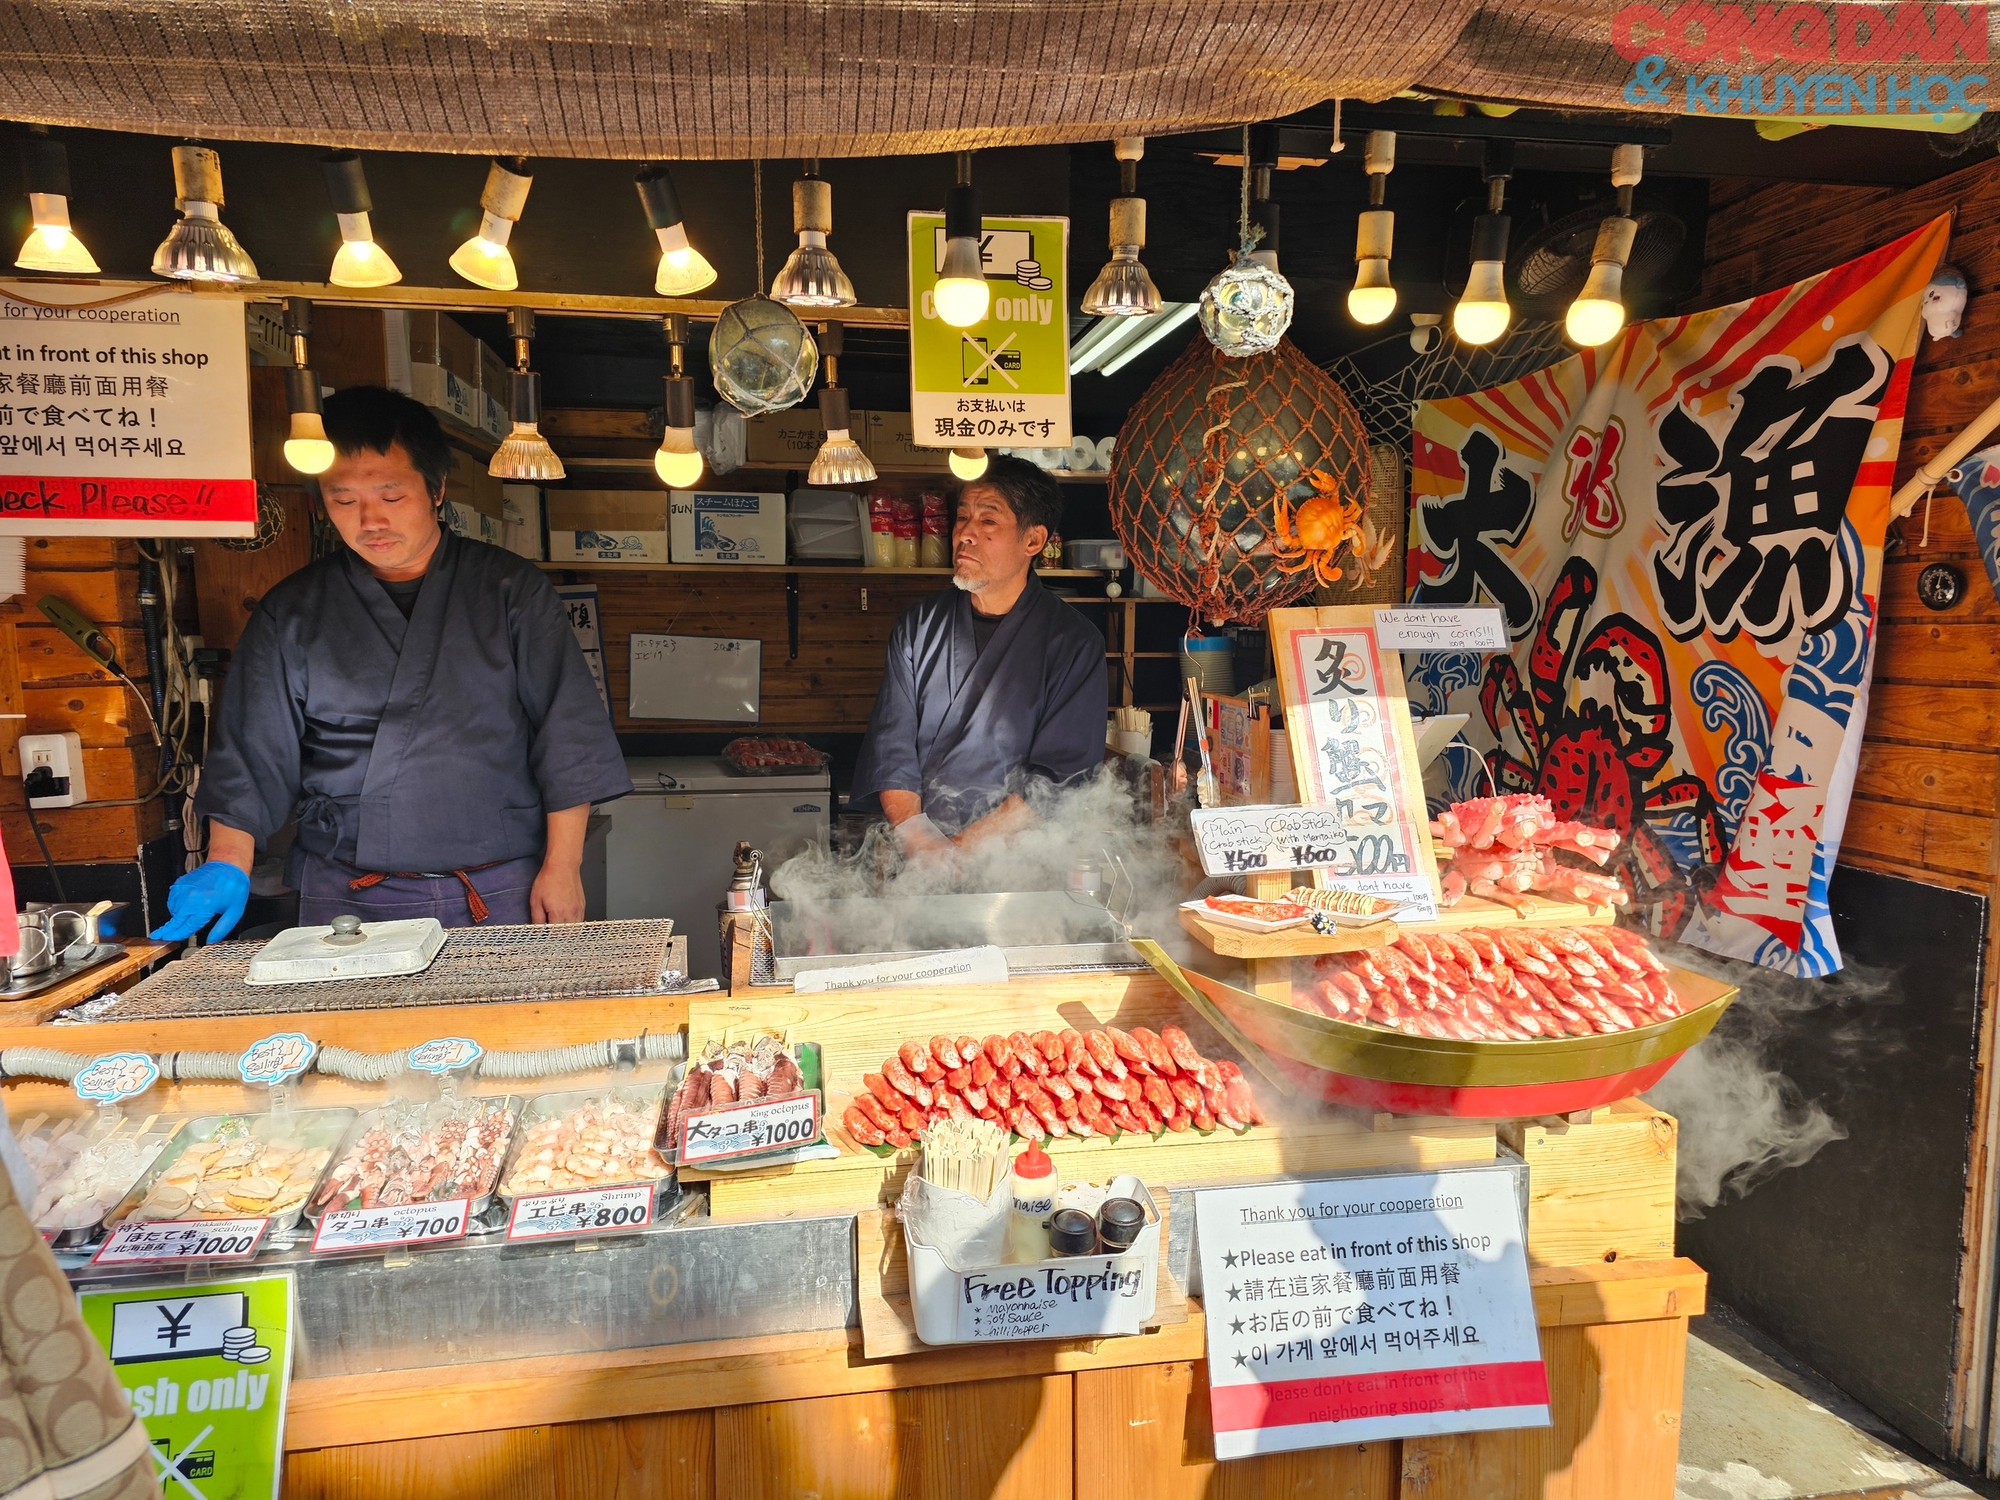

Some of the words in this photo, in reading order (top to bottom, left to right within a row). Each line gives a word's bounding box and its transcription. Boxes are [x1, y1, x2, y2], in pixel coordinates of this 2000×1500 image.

[4, 302, 28, 318] for
[33, 305, 71, 321] your
[78, 308, 181, 324] cooperation
[996, 294, 1053, 325] only
[16, 344, 35, 361] in
[40, 344, 90, 363] front
[95, 347, 117, 363] of
[121, 347, 157, 365] this
[162, 348, 209, 369] shop
[1003, 361, 1021, 369] CARD
[957, 398, 1026, 413] お支払いは
[935, 417, 1056, 438] 現金のみです
[0, 434, 67, 458] 앞에서
[75, 436, 187, 459] 먹어주세요
[0, 480, 65, 517] eck
[671, 503, 693, 515] JUN
[696, 496, 759, 509] スチームほたて
[1379, 612, 1400, 624] We
[1404, 612, 1427, 624] dont
[1430, 612, 1461, 624] have
[1398, 629, 1440, 643] enough
[1209, 823, 1242, 838] Plain
[1223, 850, 1268, 871] ¥500
[1290, 845, 1337, 866] ¥600
[1357, 880, 1379, 891] dont
[1383, 880, 1413, 890] have
[825, 979, 857, 990] Thank
[857, 977, 874, 987] you
[876, 974, 890, 984] for
[892, 971, 914, 982] your
[916, 962, 972, 978] cooperation
[251, 1043, 276, 1061] Best
[91, 1062, 119, 1076] Best
[750, 1110, 768, 1119] King
[771, 1102, 810, 1116] octopus
[687, 1119, 759, 1142] 大タコ串
[750, 1117, 814, 1147] ¥1000
[600, 1191, 641, 1202] Shrimp
[393, 1205, 437, 1216] octopus
[527, 1201, 586, 1220] エビ串
[576, 1205, 647, 1228] ¥800
[1240, 1206, 1286, 1223] Thank
[1288, 1206, 1316, 1222] you
[1319, 1202, 1340, 1217] for
[1343, 1201, 1376, 1218] your
[1379, 1194, 1463, 1214] cooperation
[117, 1223, 149, 1233] 特大
[212, 1224, 259, 1233] scallops
[330, 1216, 389, 1232] タコ串
[397, 1216, 460, 1238] ¥700
[125, 1230, 197, 1243] ほたて串
[176, 1235, 254, 1256] ¥1000
[113, 1242, 167, 1253] 北海道産
[1240, 1248, 1295, 1267] Please
[1299, 1245, 1327, 1262] eat
[1331, 1242, 1348, 1260] in
[1350, 1239, 1393, 1258] front
[1396, 1235, 1415, 1254] of
[1417, 1233, 1449, 1252] this
[1451, 1232, 1492, 1252] shop
[963, 1273, 1036, 1304] Free
[1038, 1260, 1142, 1303] Topping
[1244, 1262, 1461, 1302] 請在這家餐廳前面用餐
[986, 1299, 1058, 1313] Mayonnaise
[1248, 1295, 1453, 1334] お店の前で食べてね！
[1251, 1344, 1269, 1366] 이
[1276, 1338, 1314, 1364] 가게
[1320, 1333, 1377, 1360] 앞에서
[1384, 1325, 1480, 1350] 먹어주세요
[186, 1369, 270, 1413] only
[1314, 1381, 1352, 1398] don't
[1358, 1377, 1380, 1392] eat
[1384, 1375, 1398, 1389] in
[1402, 1371, 1439, 1388] front
[1444, 1368, 1459, 1384] of
[1463, 1366, 1487, 1382] the
[1309, 1402, 1397, 1423] neighboring
[1402, 1396, 1445, 1412] shops
[190, 1466, 213, 1477] CARD
